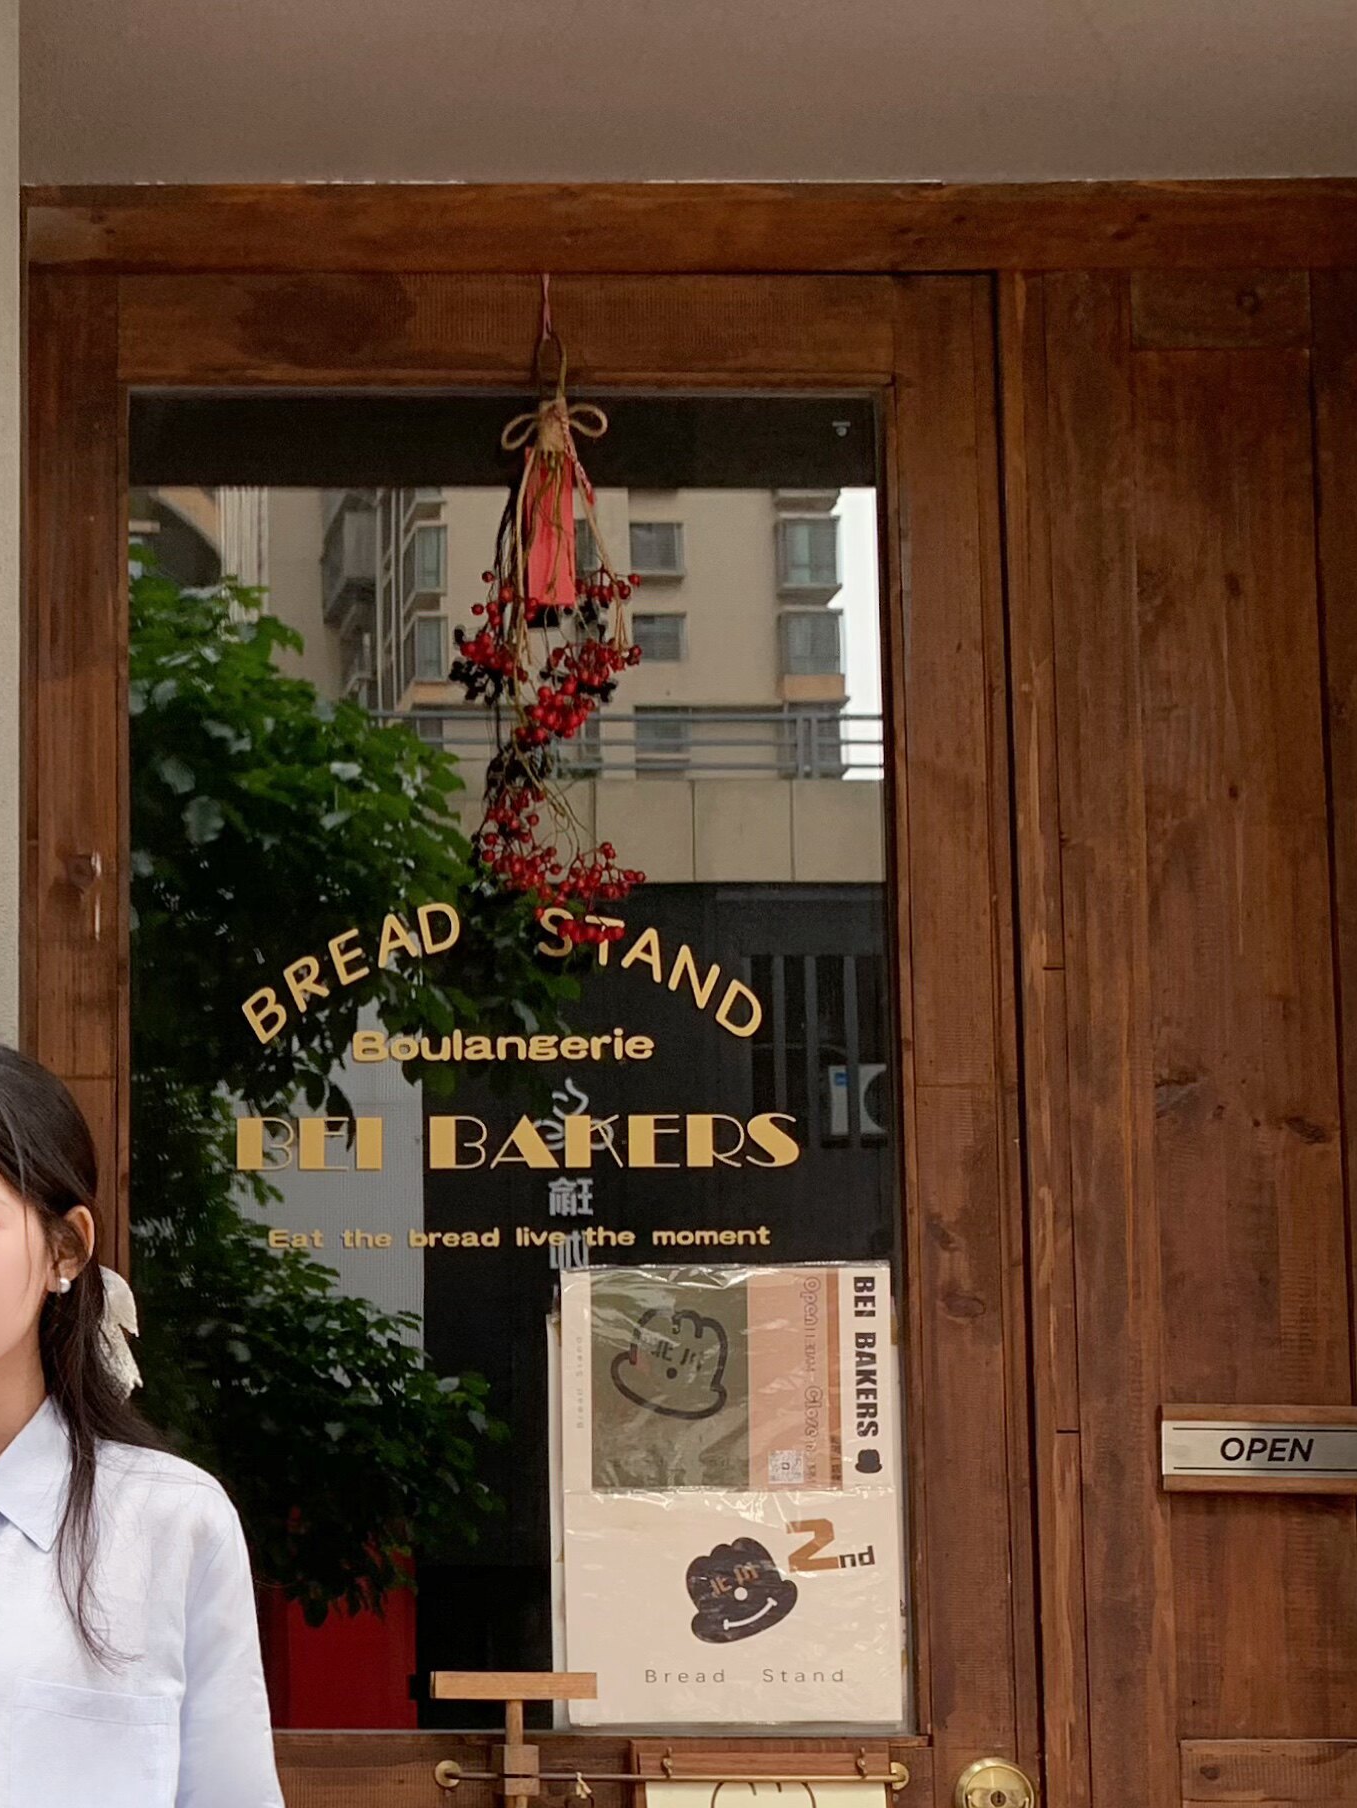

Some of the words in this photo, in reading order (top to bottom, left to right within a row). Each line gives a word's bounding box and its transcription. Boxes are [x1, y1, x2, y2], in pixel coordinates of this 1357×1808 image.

[241, 902, 462, 1045] BREAD
[537, 907, 762, 1039] STAND
[351, 1027, 655, 1063] Boulangerie
[236, 1115, 385, 1172] BEI
[429, 1112, 801, 1170] BAKERS
[268, 1228, 324, 1249] Eat
[342, 1228, 393, 1249] the
[409, 1228, 500, 1248] bread
[515, 1226, 567, 1247] live
[583, 1226, 636, 1246] the
[652, 1225, 771, 1246] moment
[800, 1275, 821, 1326] Open
[853, 1276, 876, 1318] BEI
[854, 1332, 879, 1437] BAKERS
[1220, 1437, 1314, 1462] OPEN
[645, 1669, 725, 1684] Bread
[762, 1668, 844, 1684] Stand
